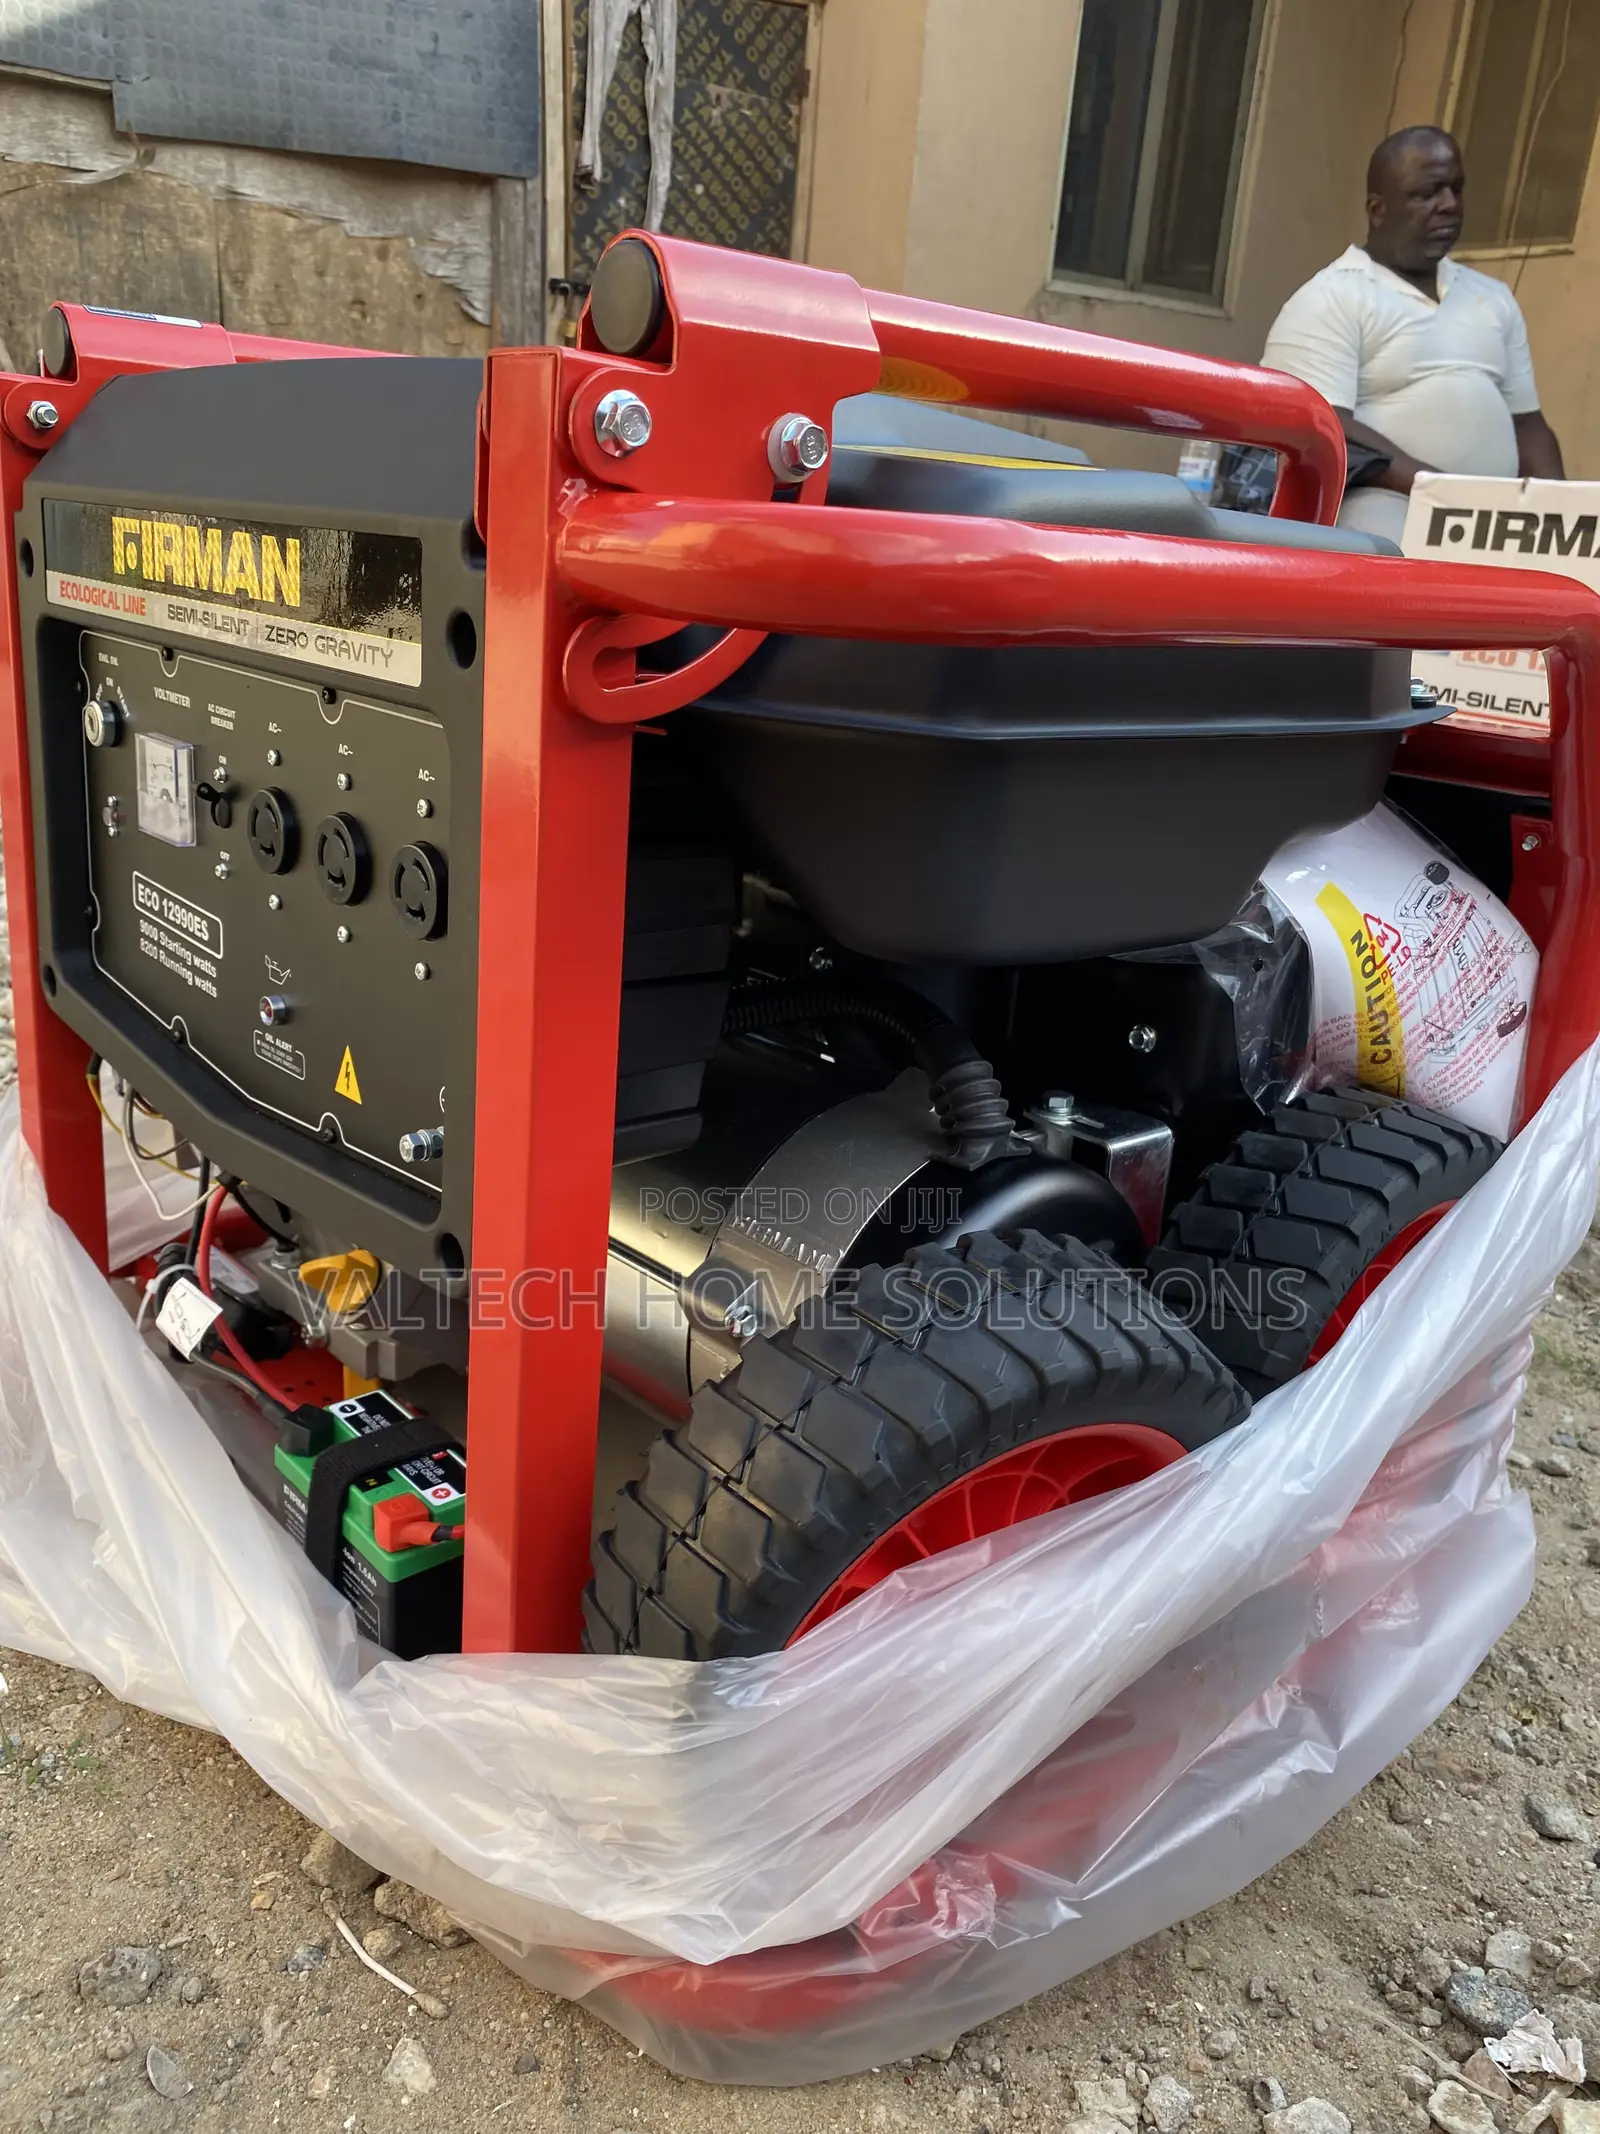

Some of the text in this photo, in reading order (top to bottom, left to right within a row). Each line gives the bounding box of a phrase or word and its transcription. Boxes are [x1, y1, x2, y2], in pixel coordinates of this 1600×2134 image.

[112, 516, 300, 607] FIRMAN
[60, 580, 146, 616] ECOLOGICAL LINE
[168, 604, 393, 668] SEMI-SILENT ZERO GRAVITY
[105, 676, 114, 687] ON
[153, 686, 191, 708] VOLTMETER
[207, 703, 236, 719] AC CIRCUIT
[210, 715, 234, 731] BREAKER
[218, 754, 227, 765] ON
[219, 851, 230, 861] OFF
[137, 883, 209, 941] ECO 12990ES
[139, 919, 217, 978] 9000 Starting watts
[1376, 929, 1389, 948] 04
[139, 937, 217, 998] 8200 Running watts
[1381, 945, 1412, 986] PE-LD
[1350, 929, 1392, 1065] CAUTION
[264, 1032, 292, 1053] OIL ALERT
